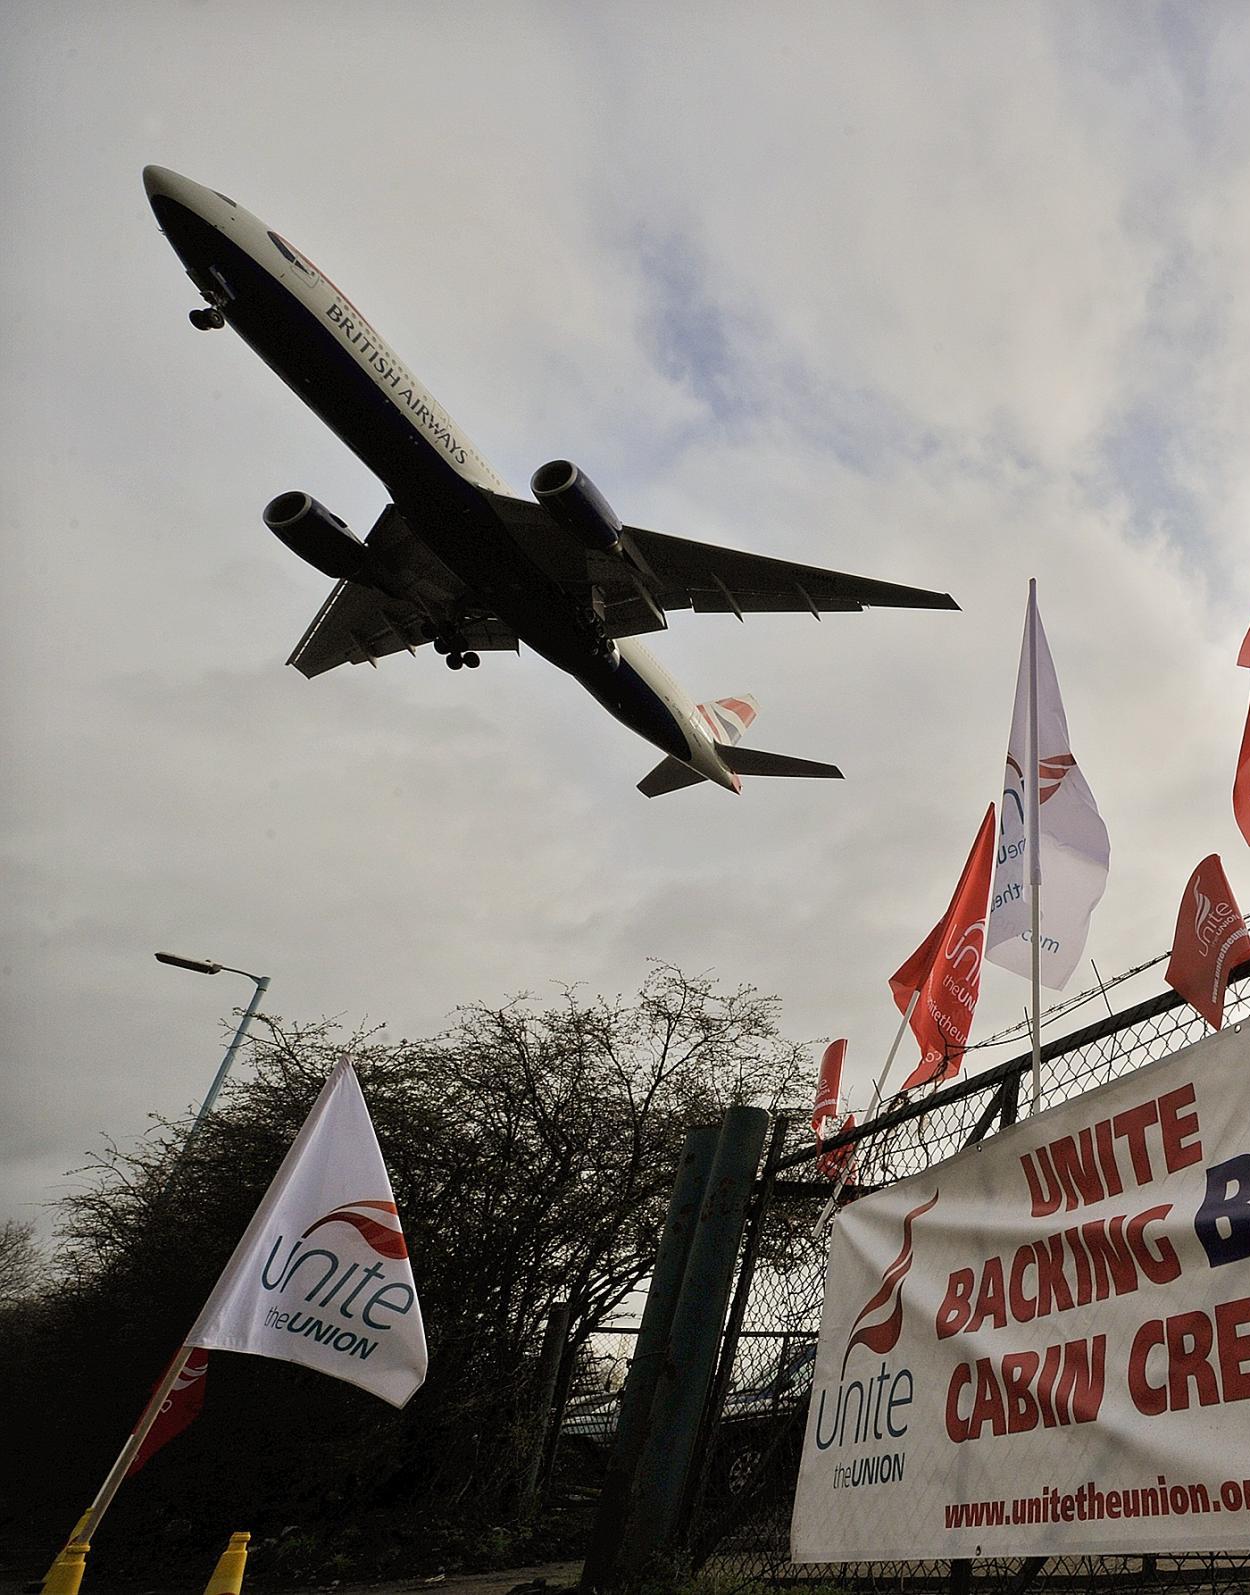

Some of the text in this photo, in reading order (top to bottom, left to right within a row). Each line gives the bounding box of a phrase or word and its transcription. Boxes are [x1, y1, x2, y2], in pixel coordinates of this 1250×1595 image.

[326, 304, 468, 465] BRITISH AIRWAYS
[1198, 902, 1233, 958] unite
[942, 974, 976, 1015] theUN
[1019, 1081, 1204, 1218] UNITE
[261, 1235, 415, 1331] unite
[935, 1203, 1183, 1341] BACKING
[264, 1305, 379, 1361] theUNION
[815, 1361, 914, 1452] unite
[944, 1333, 1107, 1445] CABIN
[832, 1452, 907, 1490] theUNION
